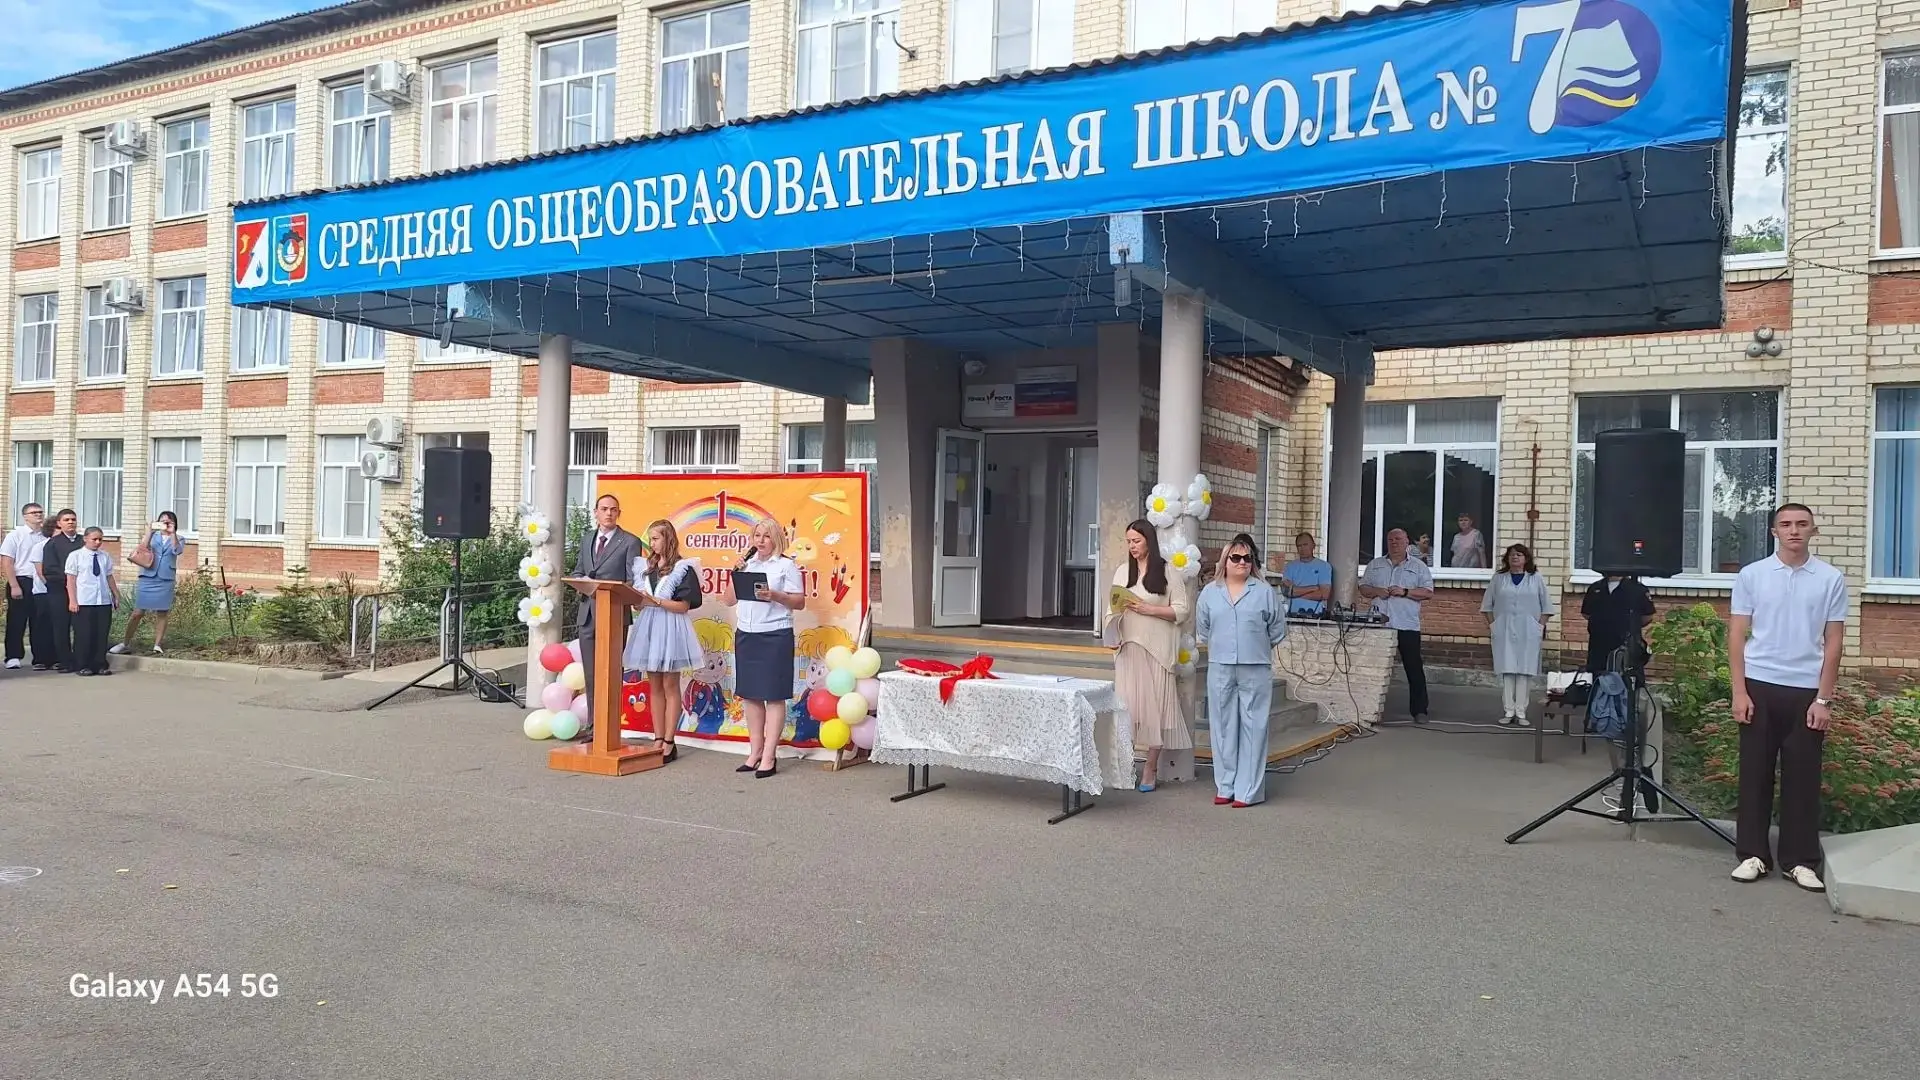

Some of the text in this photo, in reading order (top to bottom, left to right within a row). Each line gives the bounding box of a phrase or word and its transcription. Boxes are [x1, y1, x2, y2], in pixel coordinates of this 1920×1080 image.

[318, 0, 1582, 276] СРЕДНЯЯ ОБЩЕОБРАЗОВАТЕЛЬНАЯ ШКОЛА № 7
[715, 490, 727, 530] 1
[685, 529, 751, 553] сентябр
